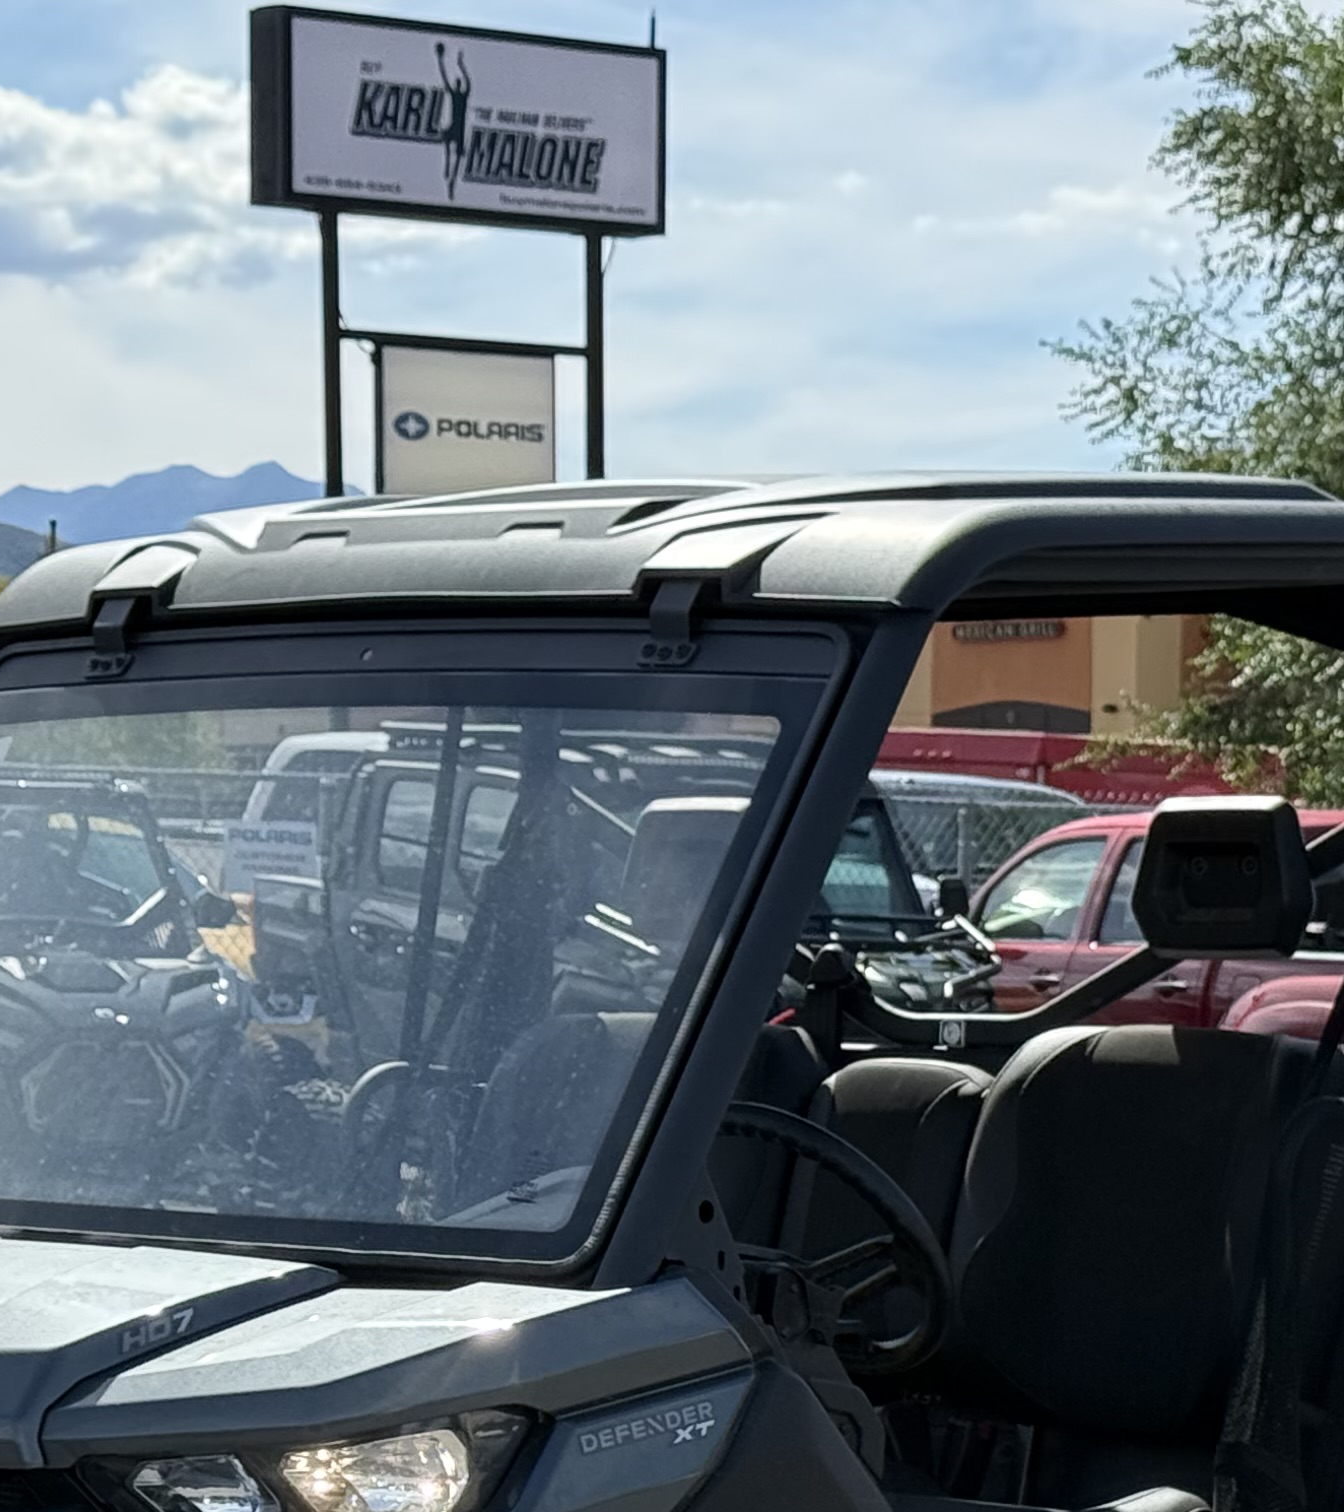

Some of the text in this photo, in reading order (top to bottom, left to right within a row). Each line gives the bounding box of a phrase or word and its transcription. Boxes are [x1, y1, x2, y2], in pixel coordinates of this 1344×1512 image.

[351, 79, 445, 143] KARL
[464, 127, 607, 193] MALONE
[437, 419, 545, 442] POLARIS
[954, 623, 1014, 641] MEXICAN
[227, 828, 313, 846] POLARIS
[122, 1307, 194, 1353] HD7
[579, 1401, 714, 1454] DEFENDER
[673, 1419, 716, 1445] XT
